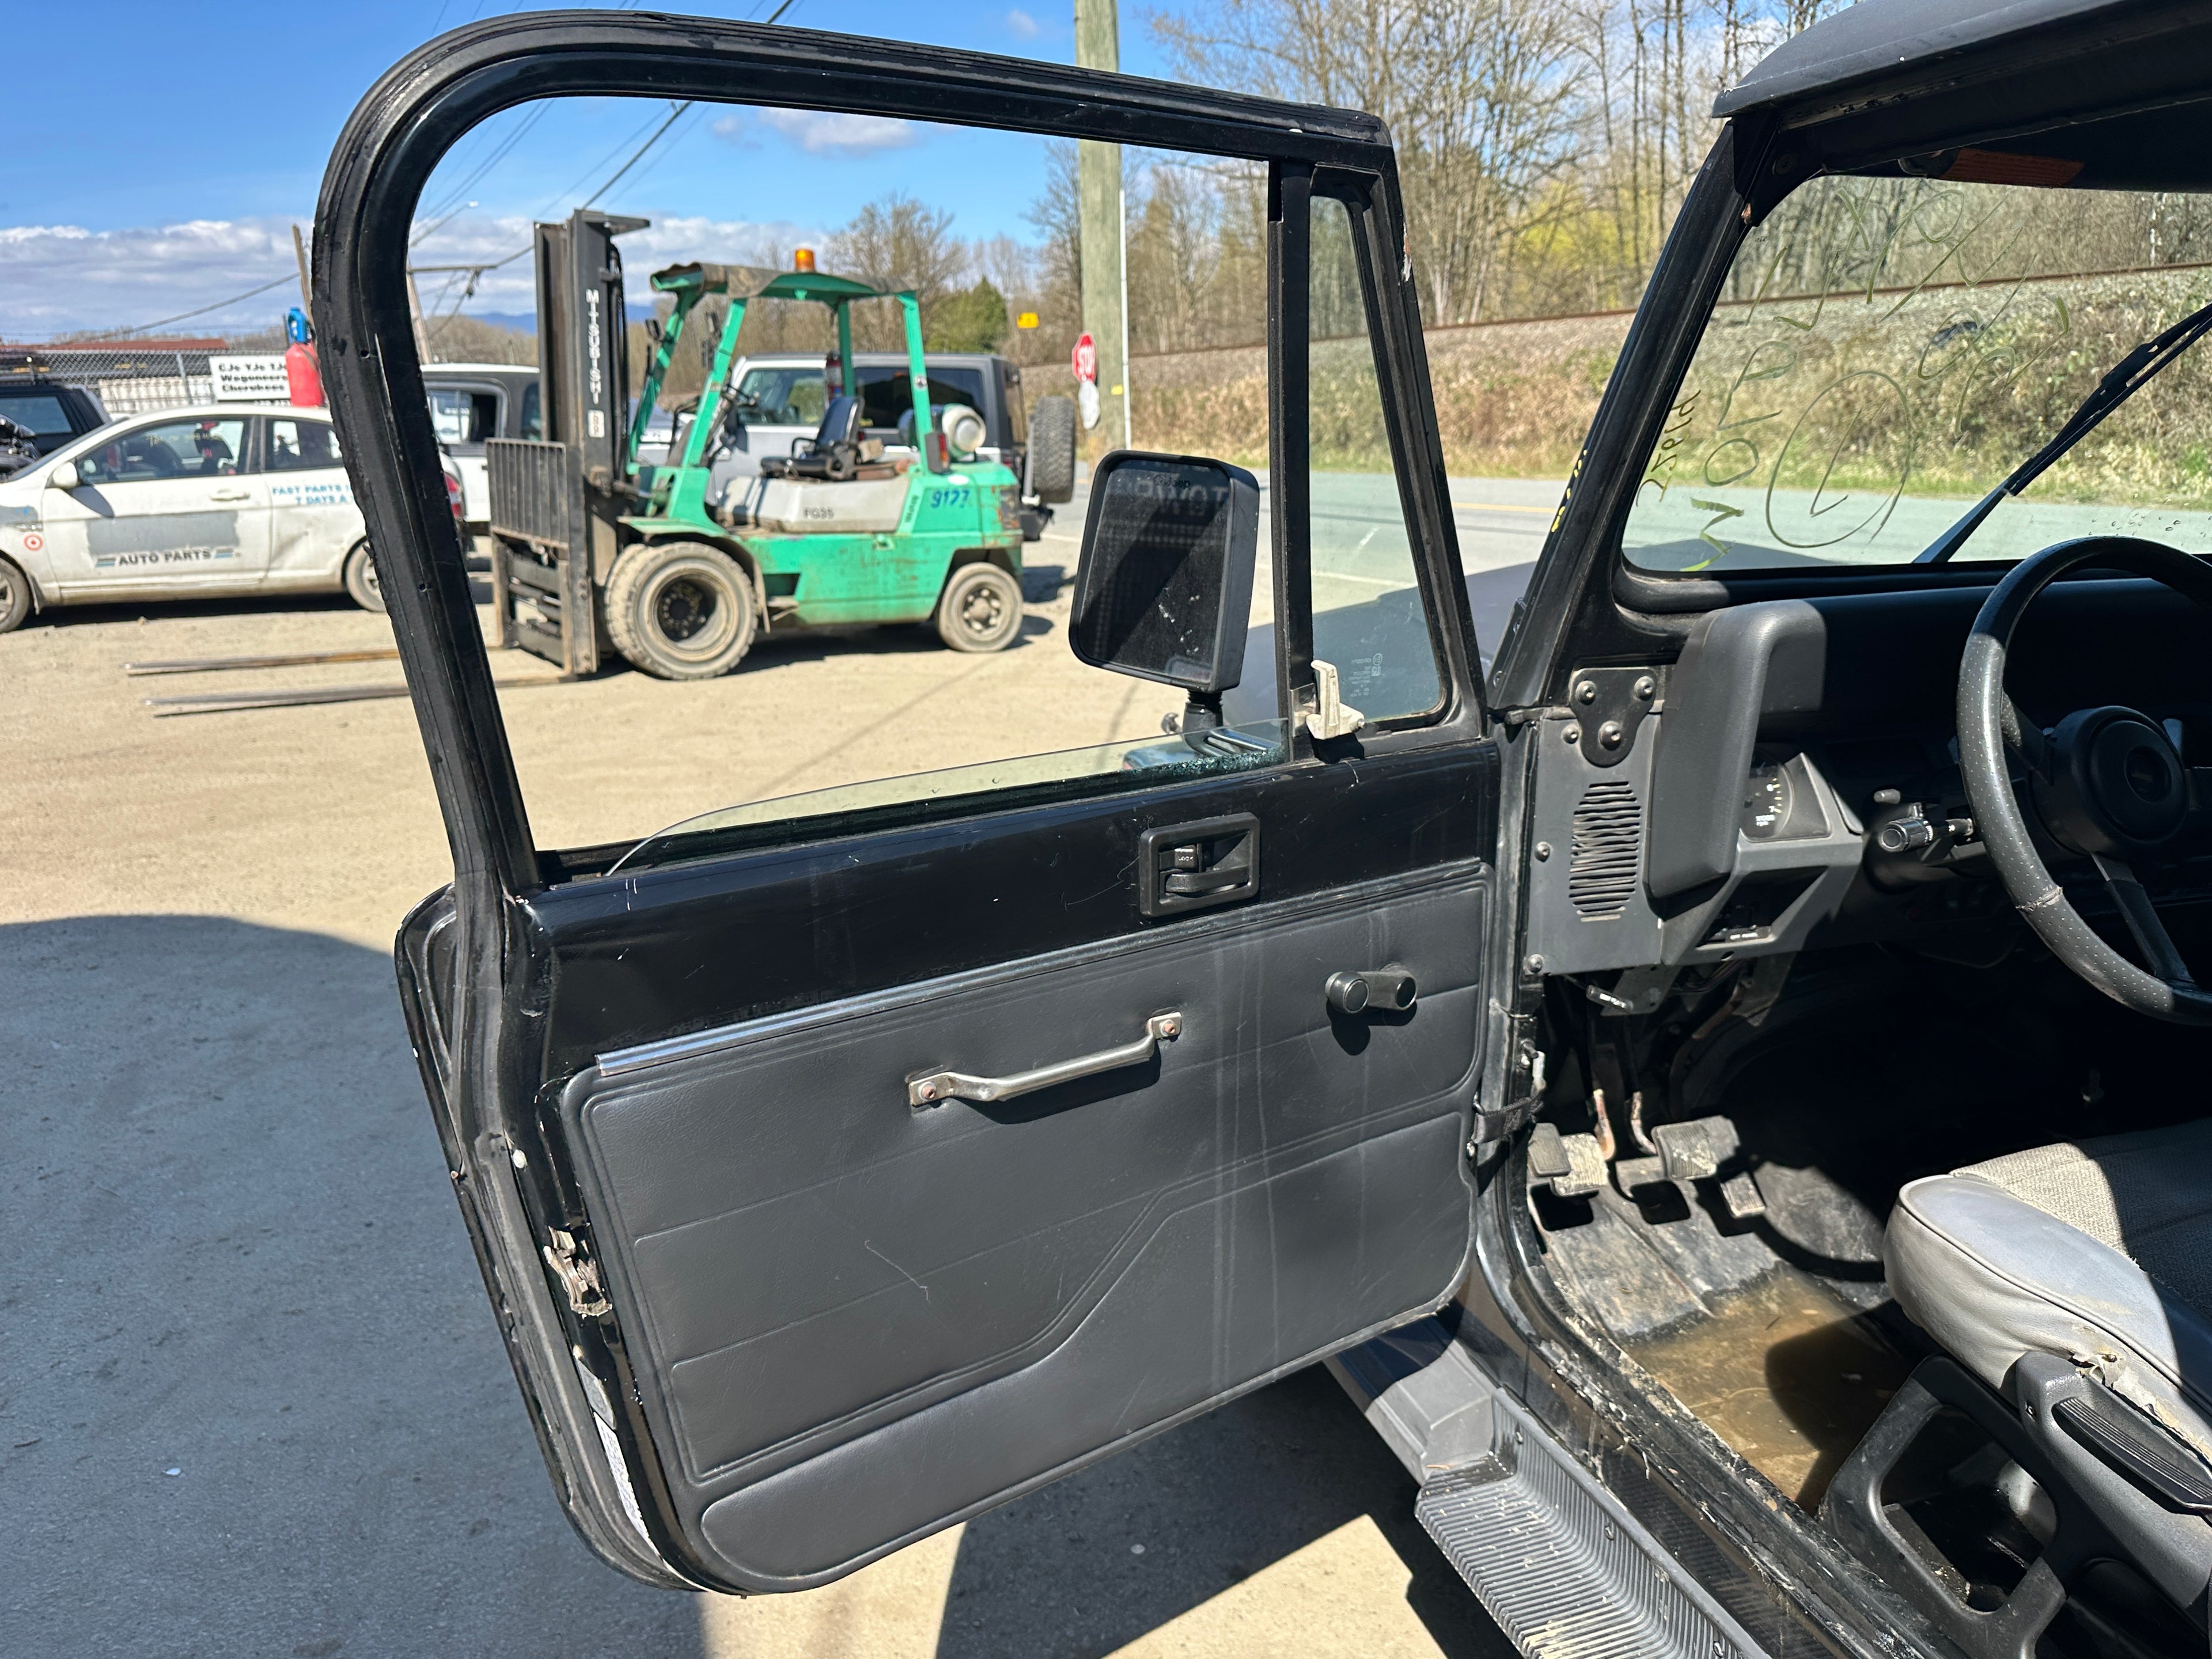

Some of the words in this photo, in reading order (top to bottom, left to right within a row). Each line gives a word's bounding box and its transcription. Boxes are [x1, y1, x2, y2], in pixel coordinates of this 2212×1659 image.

[586, 289, 601, 404] MITSUBISHI
[222, 383, 285, 392] Cherokees
[272, 485, 300, 495] FAST
[305, 483, 342, 493] PARTS
[306, 495, 335, 505] DAYS
[119, 553, 160, 566] AUTO
[164, 549, 211, 562] PARTS
